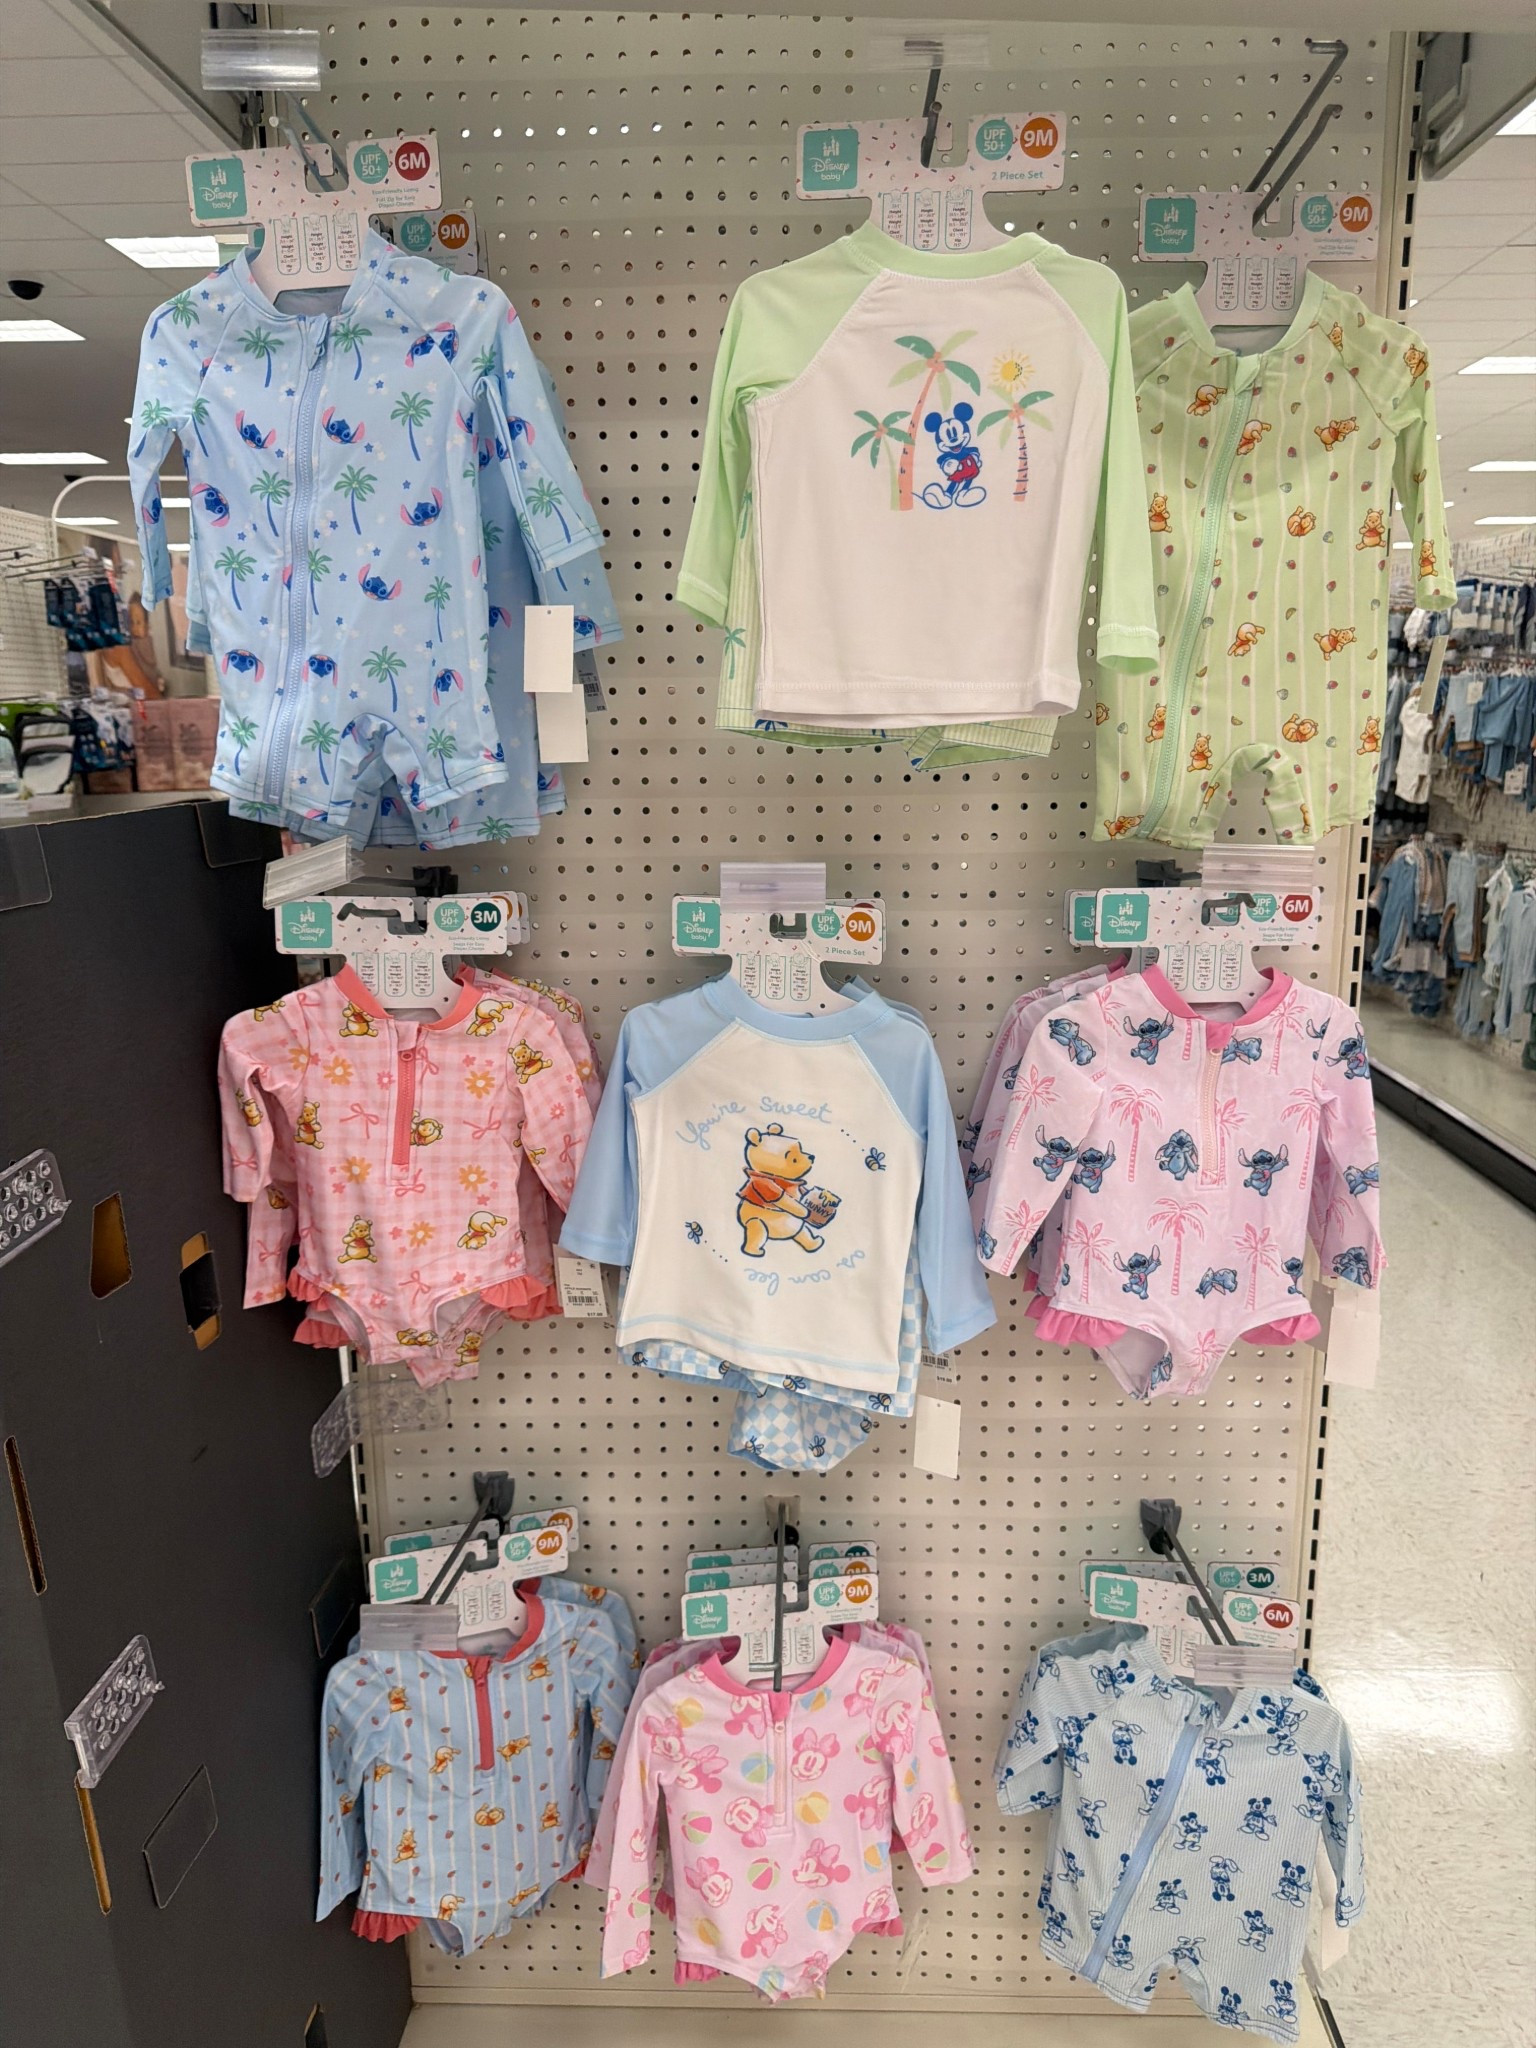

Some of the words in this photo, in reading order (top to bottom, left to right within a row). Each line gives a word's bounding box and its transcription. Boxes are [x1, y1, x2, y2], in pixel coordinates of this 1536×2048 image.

[984, 128, 1006, 140] UPF
[1024, 129, 1053, 147] 9M
[984, 141, 1006, 151] 50+
[361, 153, 381, 164] UPF
[399, 152, 426, 170] 6M
[362, 166, 382, 176] 50+
[809, 158, 850, 175] Disney
[821, 172, 840, 181] baby
[992, 172, 997, 180] 2
[1028, 171, 1043, 179] Set
[199, 187, 238, 203] Disney
[1308, 205, 1327, 214] UPF
[1343, 207, 1368, 222] 9M
[1307, 215, 1326, 224] 50+
[407, 224, 425, 233] UPF
[441, 224, 465, 239] 9M
[1151, 222, 1188, 240] Disney
[408, 235, 426, 244] 50+
[1285, 900, 1309, 913] 6M
[441, 909, 459, 917] UPF
[474, 911, 497, 923] 3M
[441, 917, 459, 925] 50+
[818, 916, 834, 924] UPF
[1107, 915, 1141, 930] Disney
[288, 922, 325, 937] Disney
[682, 921, 714, 937] Disney
[849, 920, 872, 933] 9M
[831, 947, 851, 955] Piece
[675, 1102, 746, 1150] You're
[760, 1096, 832, 1123] Sweet
[804, 1198, 832, 1217] HUNNY
[836, 1250, 865, 1268] as
[744, 1268, 779, 1296] bee
[788, 1269, 831, 1284] can
[539, 1536, 560, 1549] 9M
[1249, 1573, 1271, 1583] 3M
[848, 1585, 869, 1597] 9M
[1235, 1602, 1253, 1610] UPF
[691, 1614, 722, 1625] Disney
[1266, 1610, 1290, 1623] 6M
